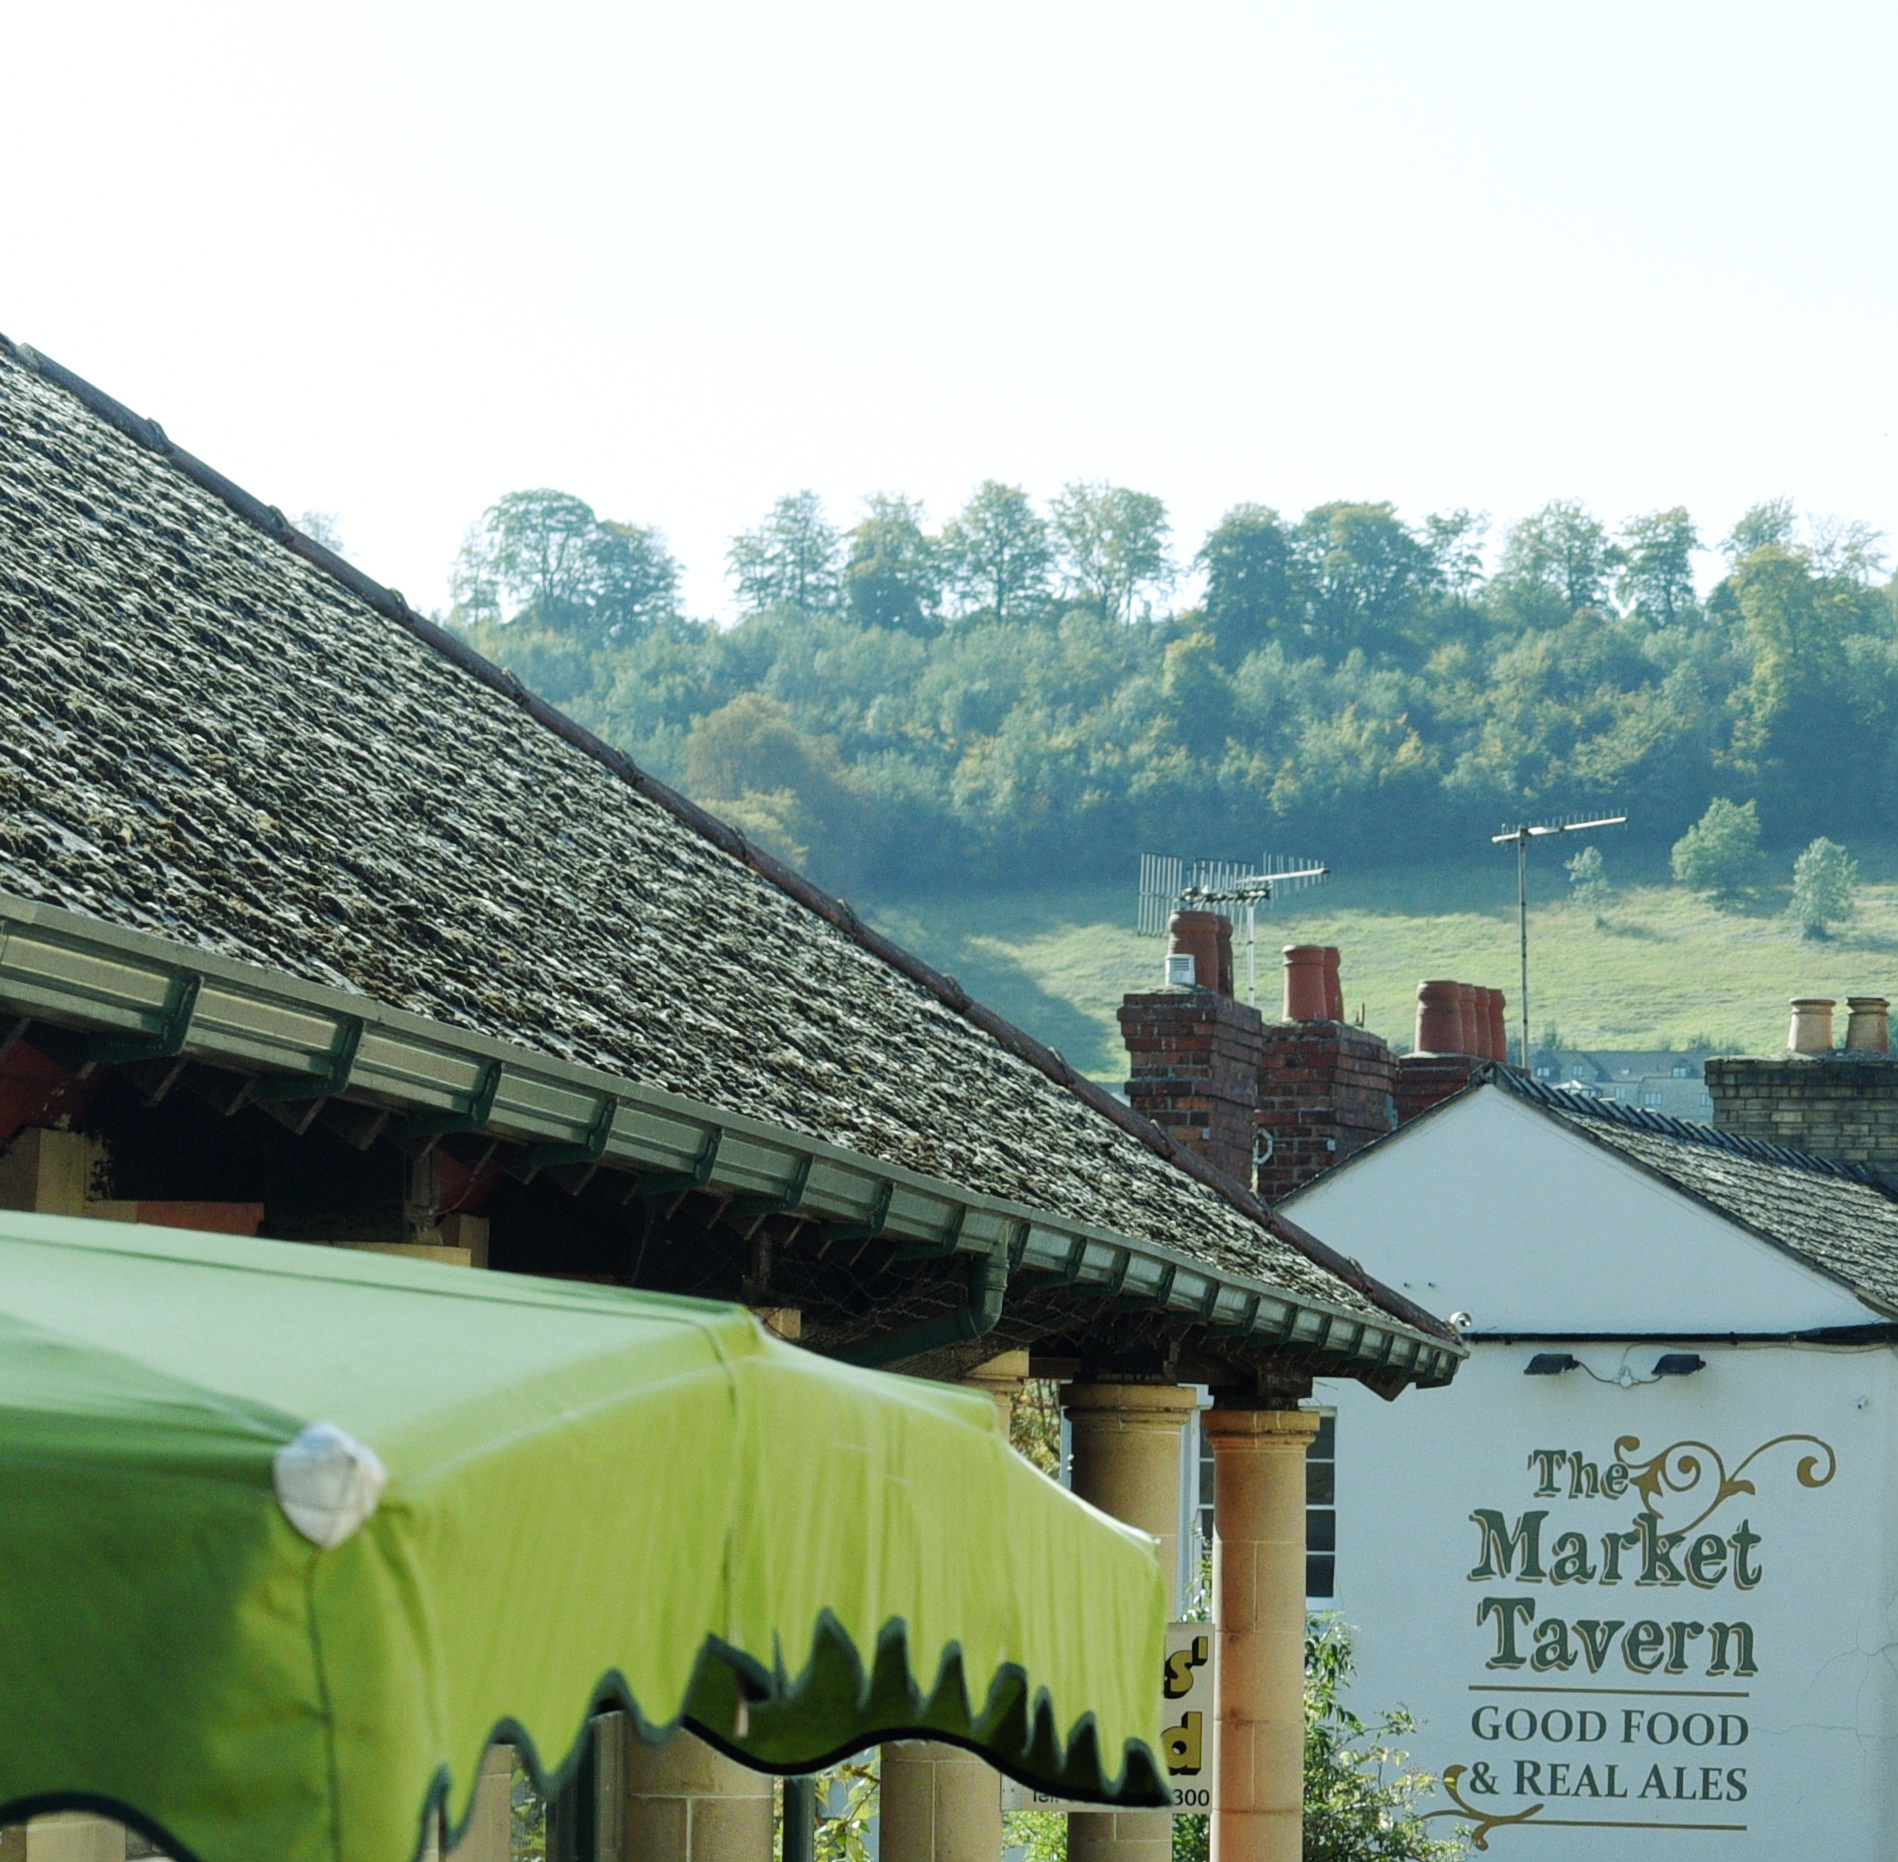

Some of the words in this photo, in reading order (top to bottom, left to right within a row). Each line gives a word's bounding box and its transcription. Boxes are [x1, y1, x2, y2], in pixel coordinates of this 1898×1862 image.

[1527, 1448, 1632, 1500] The
[1466, 1508, 1763, 1590] Market
[1476, 1597, 1759, 1678] Tavern
[1470, 1705, 1607, 1743] GOOD
[1620, 1708, 1749, 1747] FOOD
[1468, 1759, 1500, 1796] &
[1513, 1759, 1629, 1800] REAL
[1639, 1762, 1748, 1802] ALES
